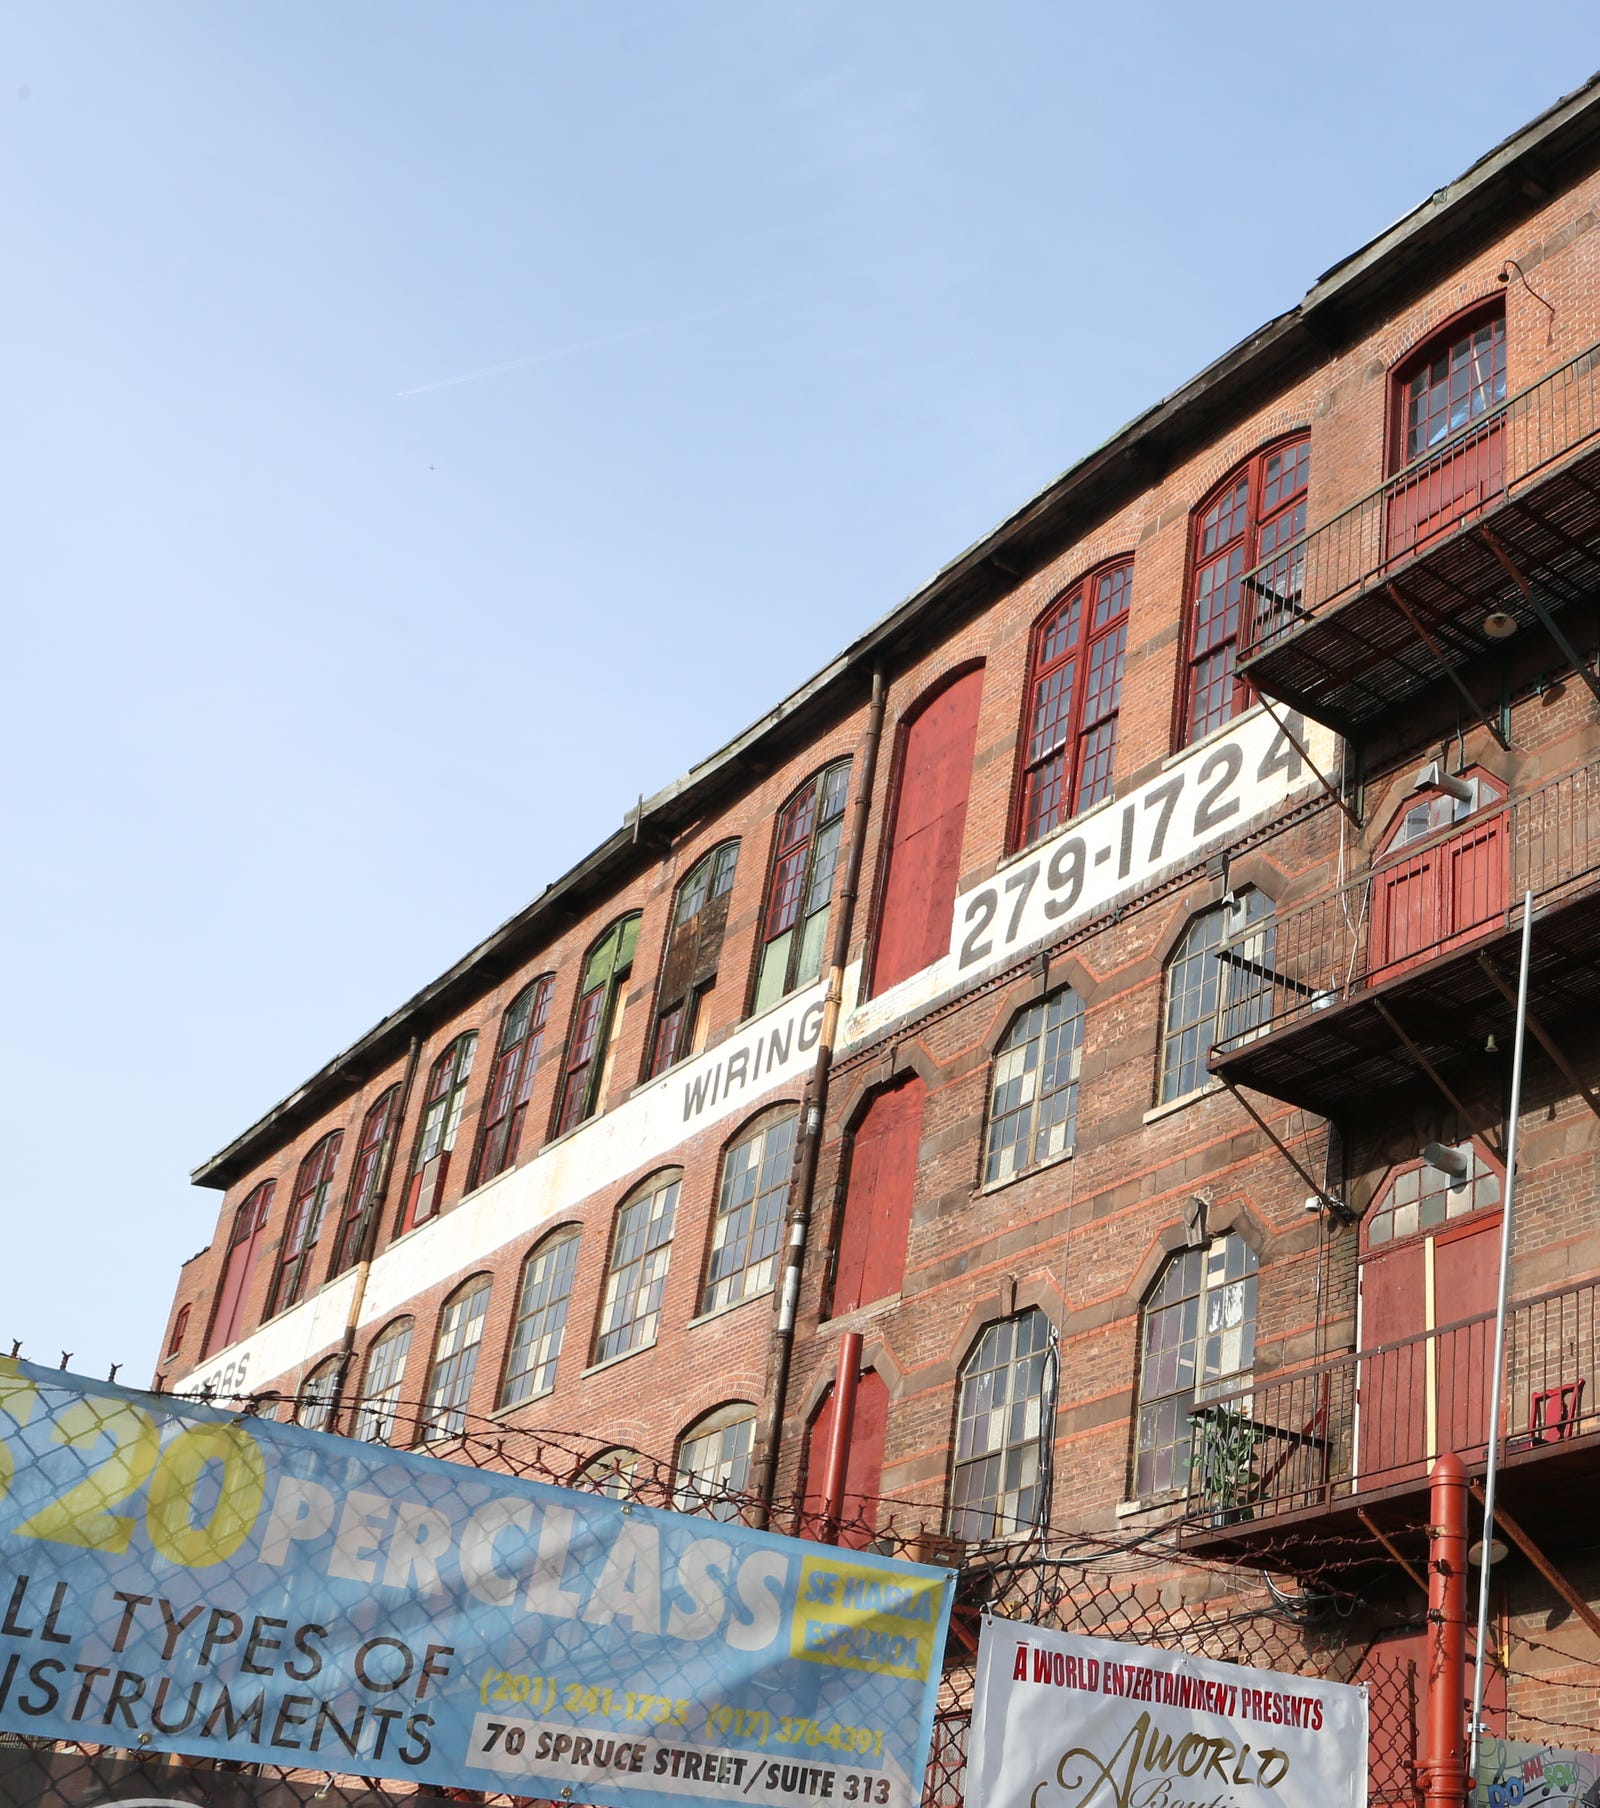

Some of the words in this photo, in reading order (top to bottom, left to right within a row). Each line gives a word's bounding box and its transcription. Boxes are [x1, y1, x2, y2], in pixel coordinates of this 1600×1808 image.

[958, 707, 1310, 971] 279-1724
[683, 1000, 826, 1123] WIRING
[805, 1570, 841, 1606] SE
[842, 1577, 933, 1623] HABLA
[111, 1591, 329, 1682] TYPES
[354, 1636, 455, 1699] OF
[480, 1667, 557, 1716] (201)
[562, 1683, 690, 1727] 241-1735
[706, 1703, 771, 1747] (917)
[1034, 1648, 1100, 1692] WORLD
[1103, 1661, 1238, 1717] ENTERTAINMENT
[1241, 1687, 1324, 1731] PRESENTS
[482, 1723, 526, 1756] 70
[535, 1731, 647, 1773] SPRUCE
[843, 1774, 892, 1805] 313
[1487, 1776, 1525, 1808] DO
